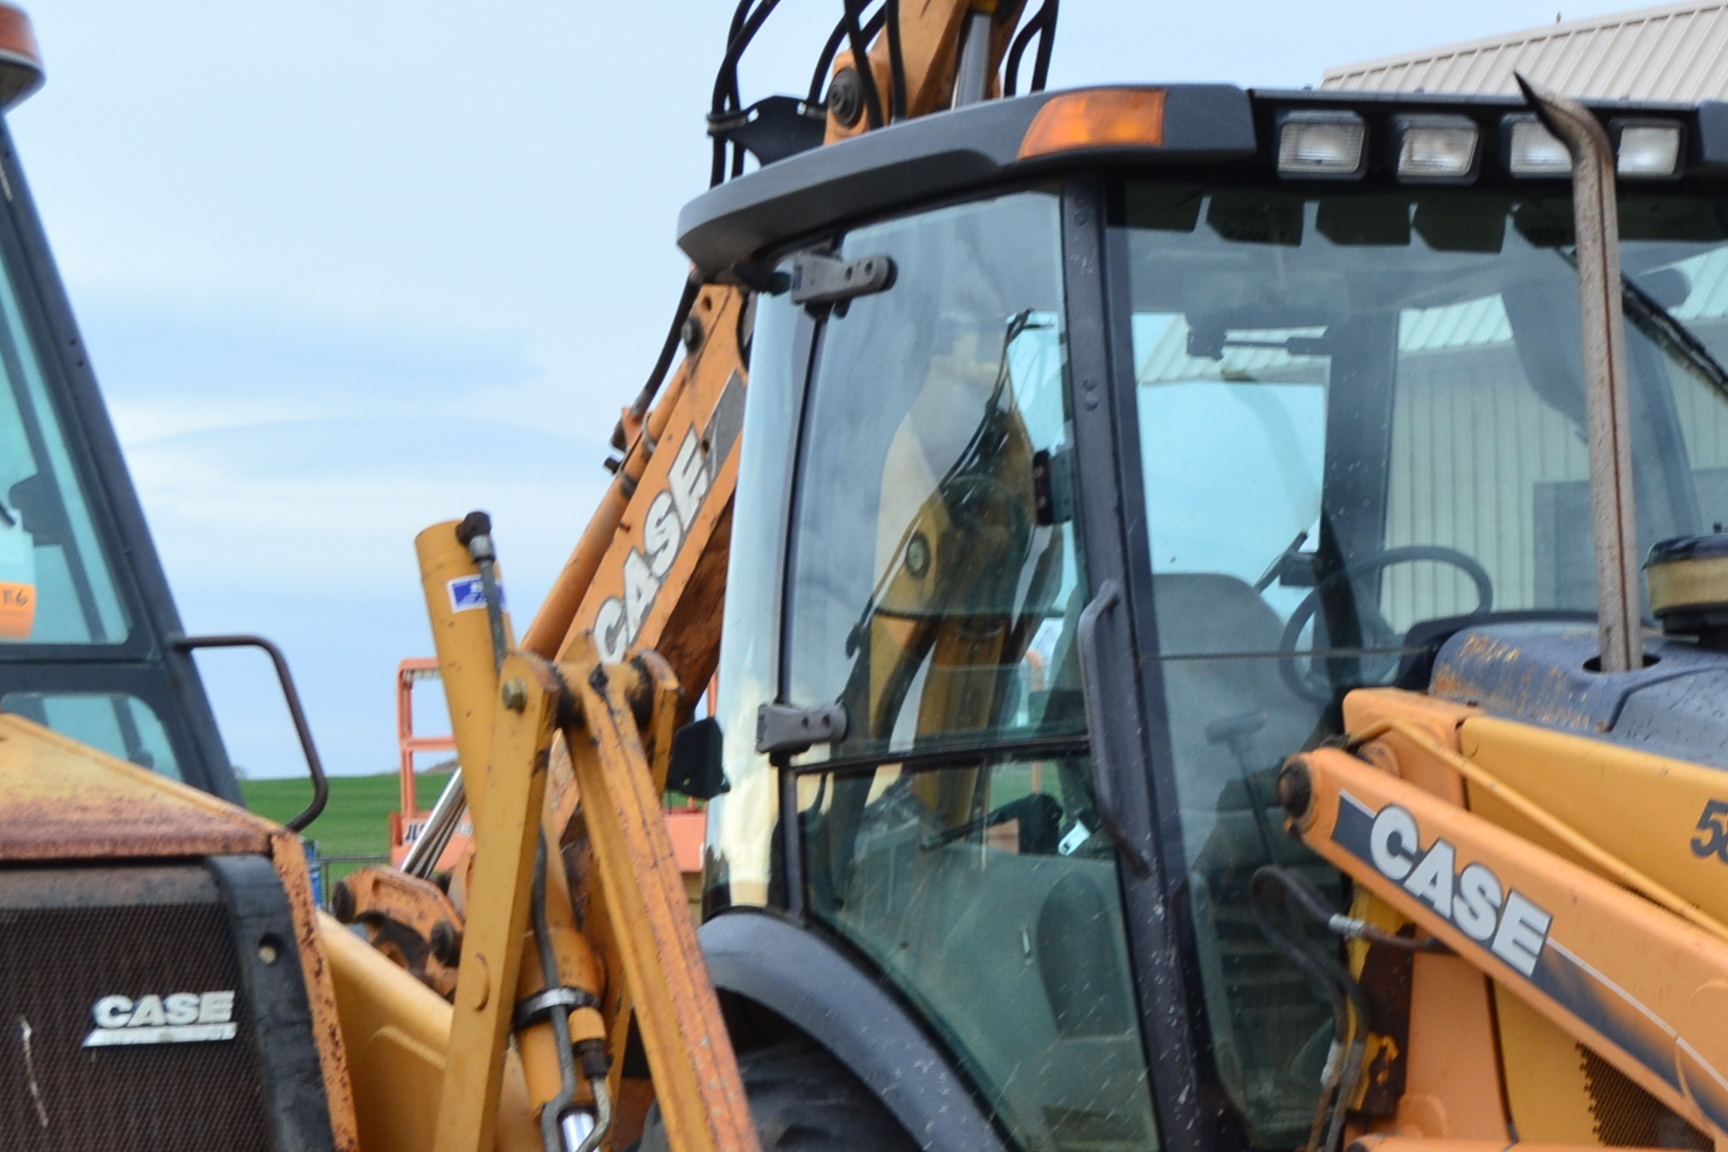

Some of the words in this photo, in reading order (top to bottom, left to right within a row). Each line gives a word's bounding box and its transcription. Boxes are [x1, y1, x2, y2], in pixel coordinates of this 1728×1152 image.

[594, 423, 709, 665] CASE
[1369, 804, 1553, 978] CASE
[94, 990, 235, 1029] CASE
